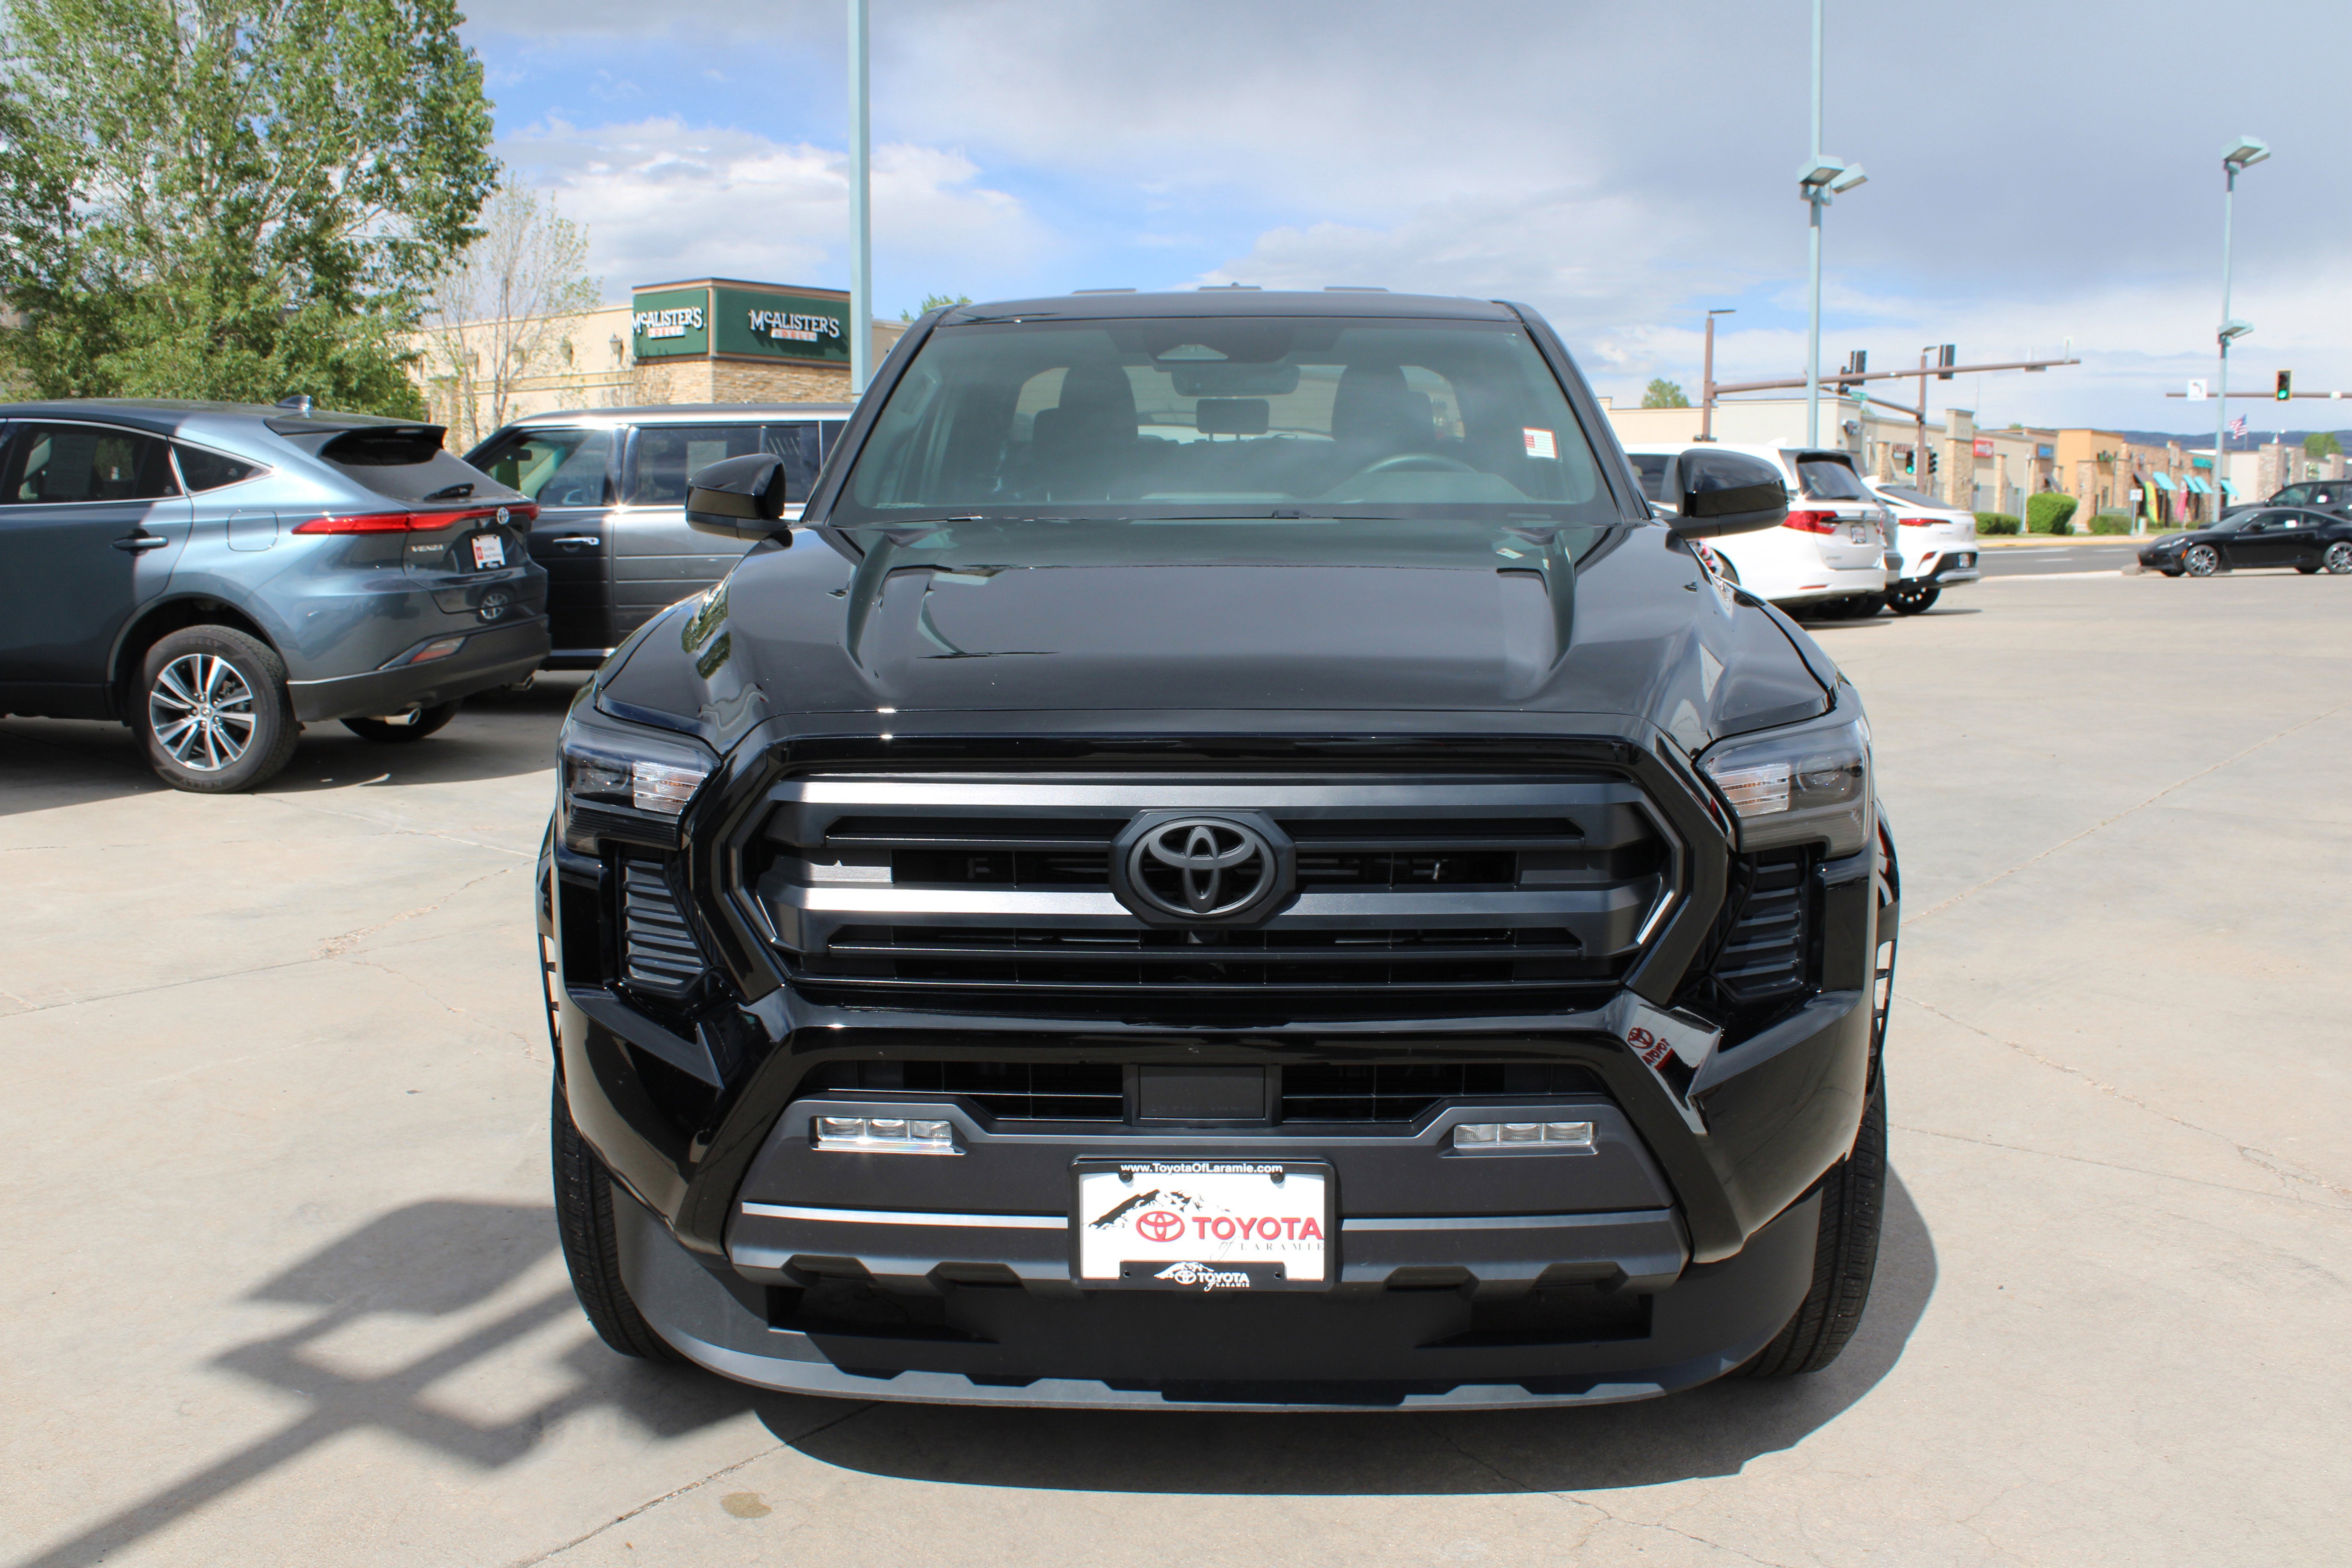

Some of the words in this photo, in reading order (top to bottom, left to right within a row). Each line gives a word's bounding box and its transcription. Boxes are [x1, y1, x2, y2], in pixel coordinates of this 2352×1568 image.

[655, 327, 677, 336] DELI
[782, 330, 810, 340] DELI
[411, 544, 443, 552] VENZA
[1120, 1162, 1283, 1174] www.ToyotaOfLaramie.com
[1192, 1216, 1324, 1241] TOYOTA
[1210, 1236, 1240, 1261] of
[1197, 1272, 1250, 1283] TOYOTA
